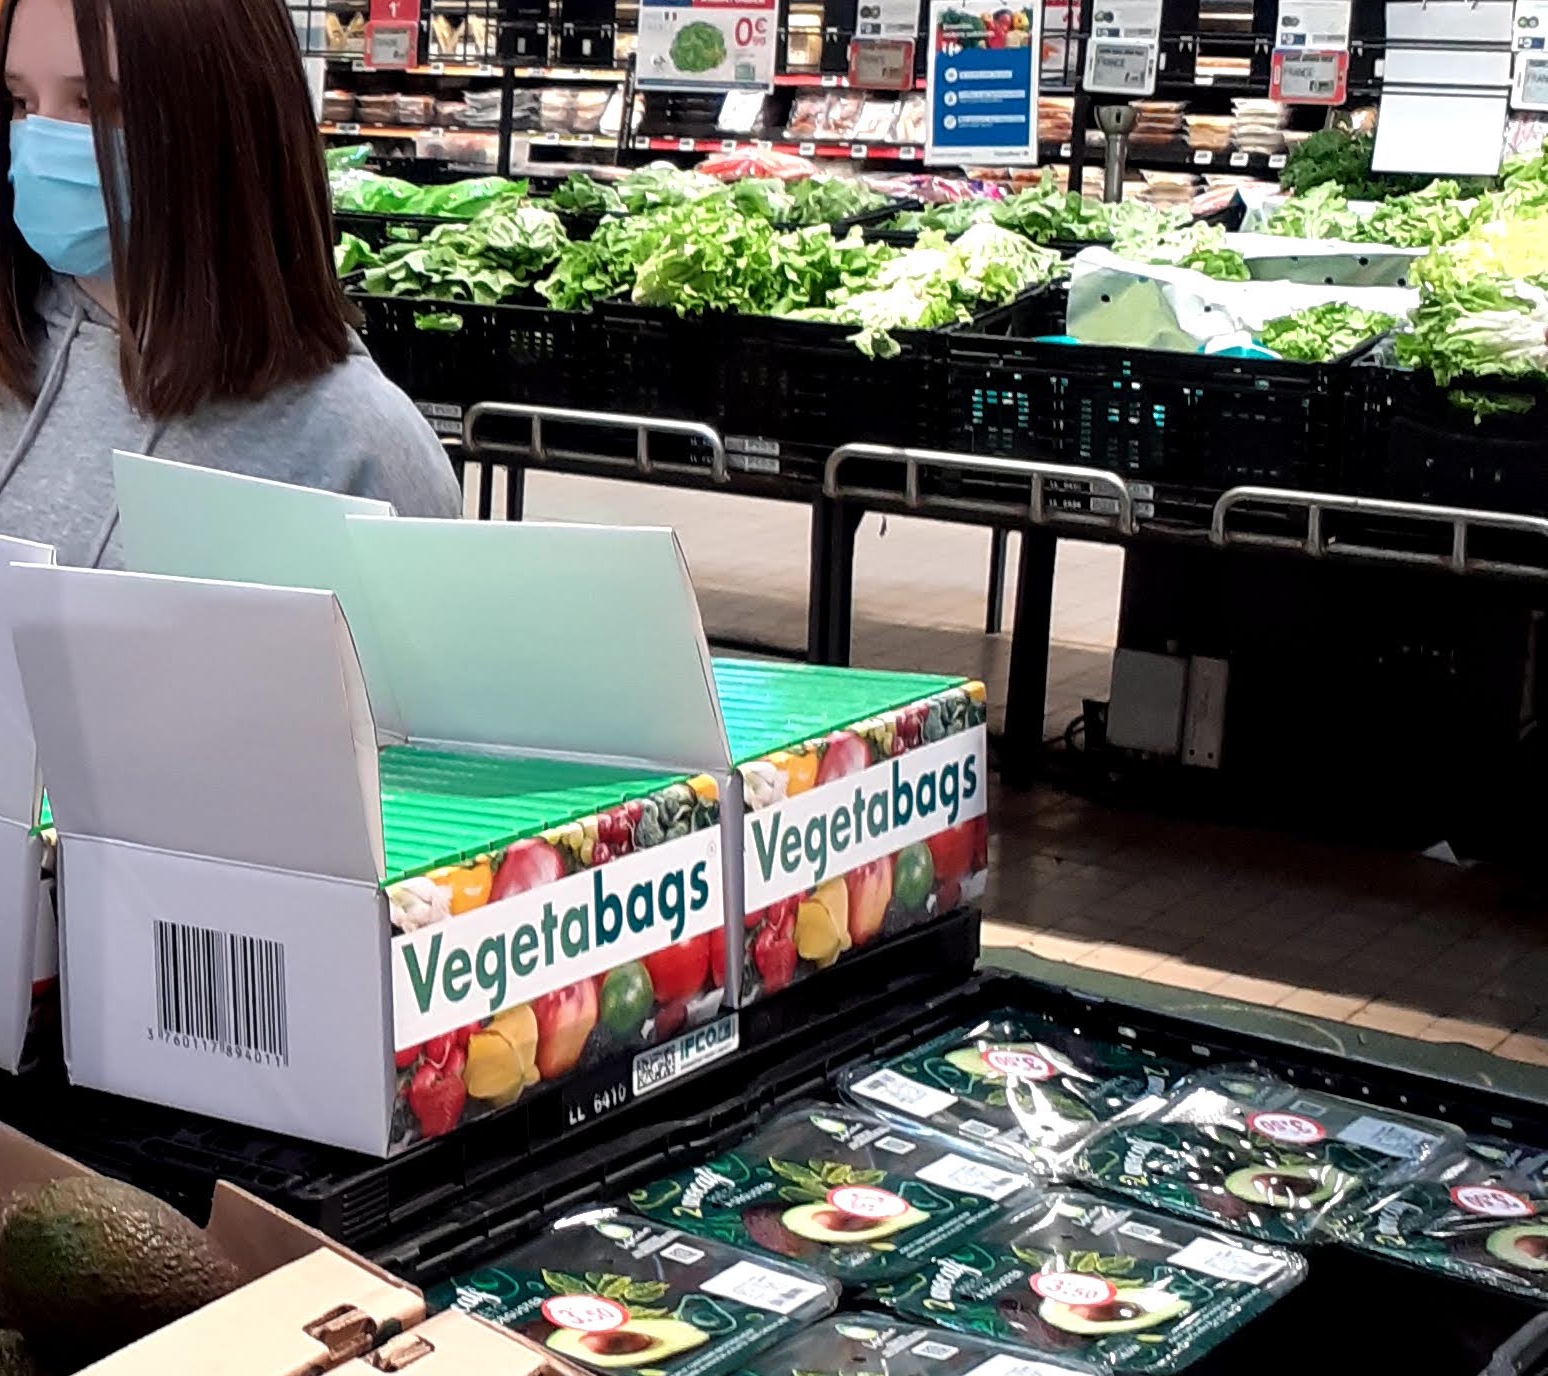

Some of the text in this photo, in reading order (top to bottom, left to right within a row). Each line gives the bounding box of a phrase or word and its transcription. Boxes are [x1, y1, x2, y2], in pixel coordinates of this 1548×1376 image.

[751, 753, 978, 882] Vegetabags
[402, 859, 710, 1013] Vegetabags
[680, 1026, 717, 1061] IFCO
